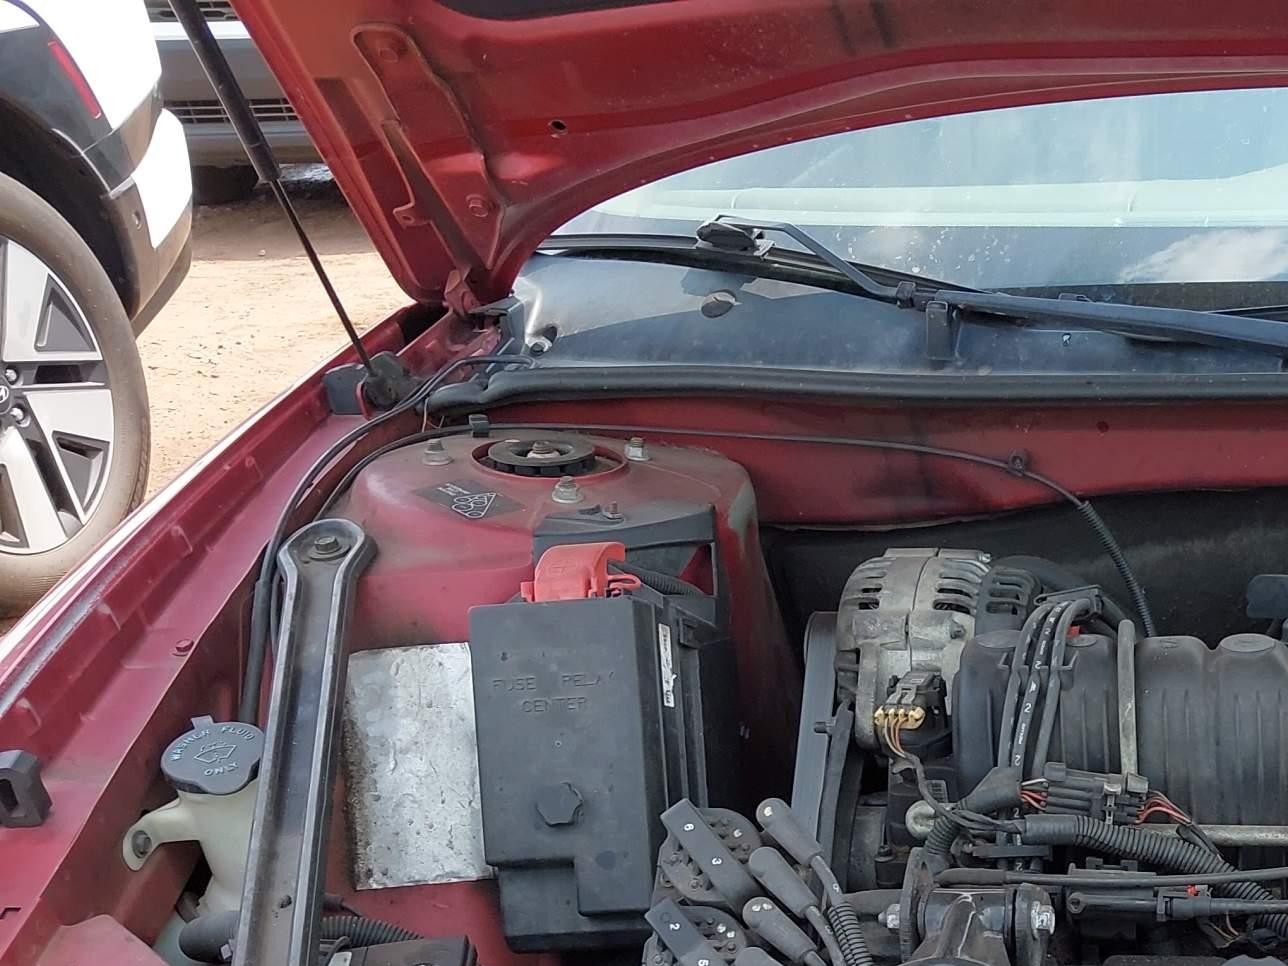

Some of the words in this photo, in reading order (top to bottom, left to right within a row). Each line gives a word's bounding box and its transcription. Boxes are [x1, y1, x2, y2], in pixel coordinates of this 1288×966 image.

[492, 676, 537, 692] FUSE
[521, 696, 587, 713] CENTER
[220, 725, 255, 741] FLUID
[203, 761, 239, 777] ONLY
[669, 922, 681, 931] 2
